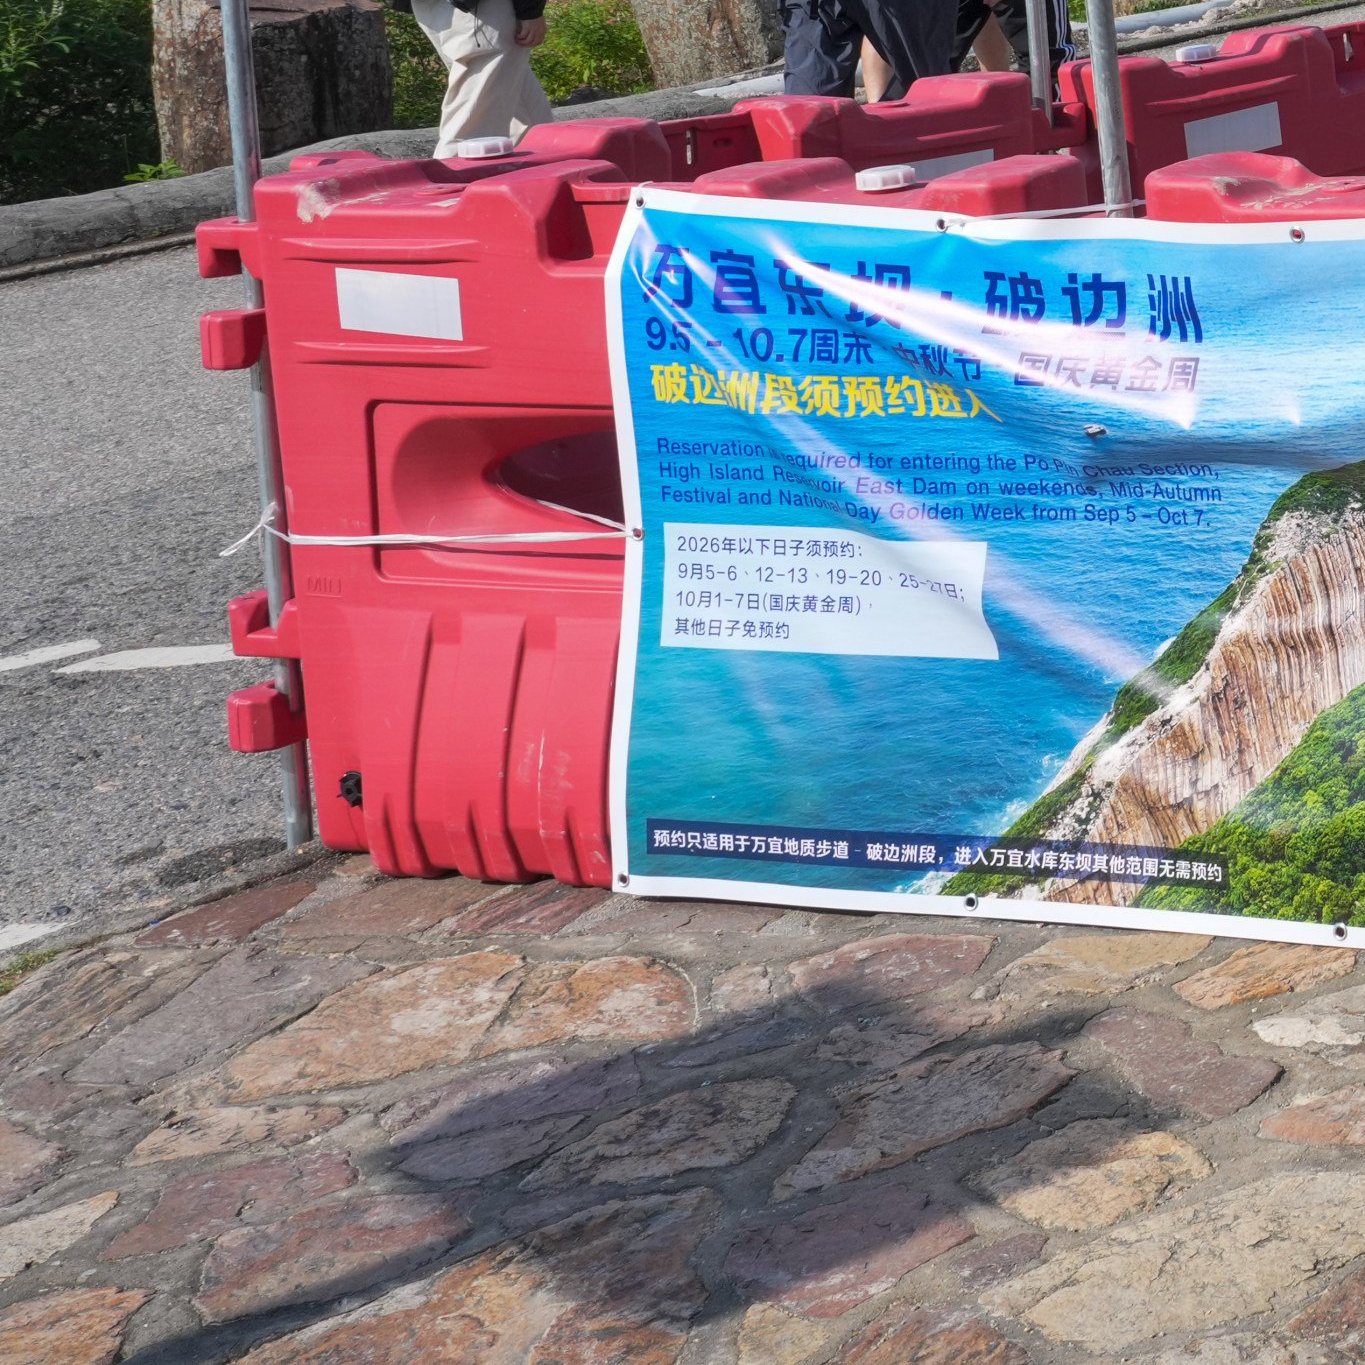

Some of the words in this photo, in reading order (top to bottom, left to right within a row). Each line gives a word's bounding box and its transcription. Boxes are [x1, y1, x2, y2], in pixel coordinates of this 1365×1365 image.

[657, 438, 764, 458] Reservation
[784, 452, 861, 471] required
[868, 452, 893, 469] for
[901, 452, 980, 474] entering
[987, 453, 1016, 471] the
[1024, 454, 1049, 471] Po
[1053, 458, 1079, 477] Pin
[1083, 462, 1134, 478] Chau
[1141, 462, 1219, 479] Section,
[660, 462, 700, 482] High
[710, 464, 764, 482] Island
[773, 465, 846, 494] Reservoir
[855, 477, 902, 494] East
[913, 477, 957, 495] Dam
[967, 482, 989, 495] on
[1000, 478, 1103, 499] weekends,
[1110, 481, 1222, 502] Mid-Autumn
[662, 486, 730, 504] Festival
[738, 488, 771, 506] and
[779, 490, 841, 511] National
[845, 503, 880, 523] Day
[889, 502, 964, 521] Golden
[971, 503, 1025, 521] Week
[1032, 503, 1076, 521] from
[1084, 503, 1119, 525] Sep
[1126, 505, 1136, 522] 5
[1157, 507, 1188, 525] Oct
[1194, 509, 1210, 527] 7.
[674, 617, 790, 639] 其他日子免预约
[653, 829, 849, 860] 预约只适用于万宜地质步道
